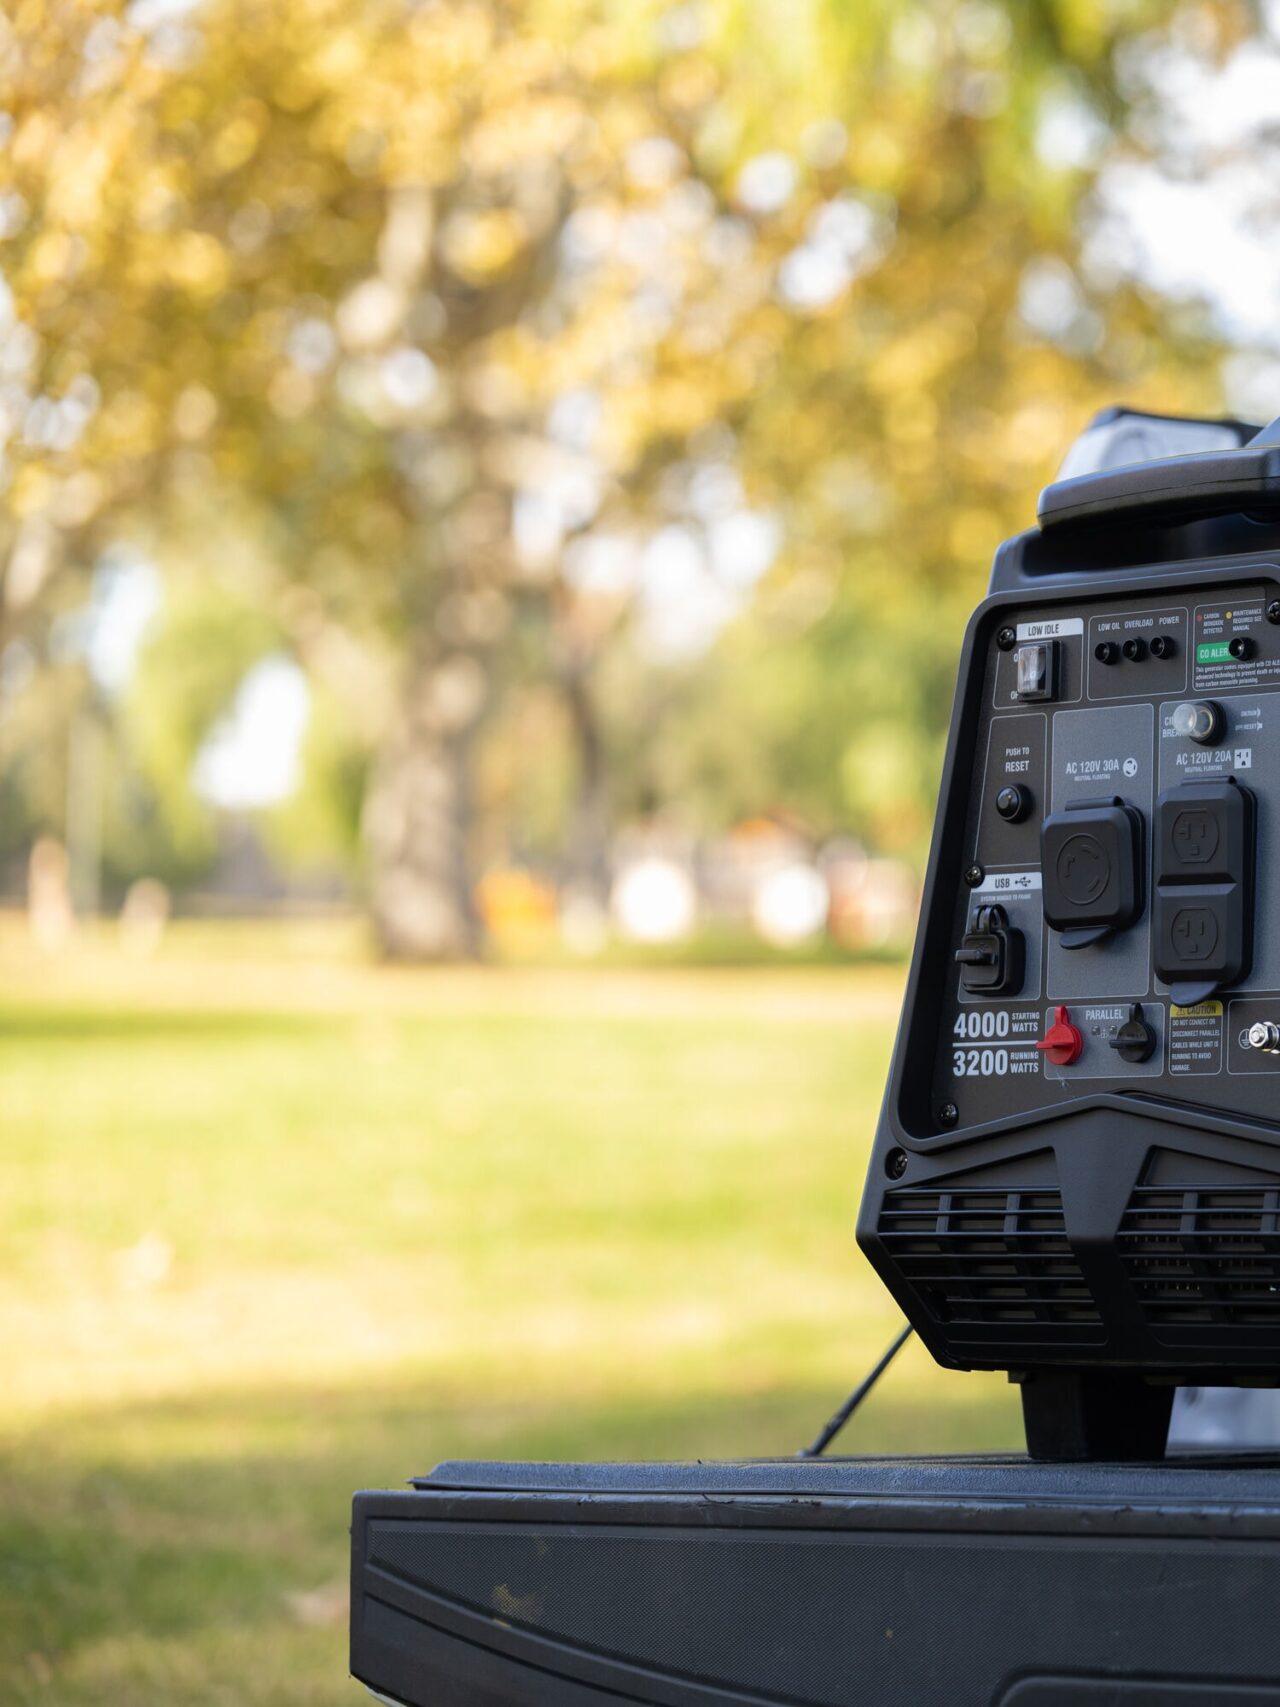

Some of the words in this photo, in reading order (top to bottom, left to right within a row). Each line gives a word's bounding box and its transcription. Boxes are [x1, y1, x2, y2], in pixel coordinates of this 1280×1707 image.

[1233, 608, 1262, 616] MAINTENANCE
[1124, 618, 1154, 629] OVERLOAD
[1159, 616, 1180, 624] POWER
[1028, 625, 1043, 636] LOW
[1044, 624, 1060, 634] IDLE
[1098, 623, 1110, 631] LOW
[1112, 622, 1120, 630] OIL
[1200, 649, 1209, 659] CO
[1210, 648, 1230, 658] ALER
[1006, 748, 1021, 756] PUSH
[1022, 747, 1030, 755] TO
[1176, 753, 1188, 765] AC
[1190, 752, 1212, 764] 120V
[1215, 750, 1232, 763] 20A
[1005, 760, 1030, 772] RESET
[1066, 762, 1077, 774] AC
[1080, 760, 1100, 773] 120V
[1103, 759, 1119, 771] 30A
[995, 878, 1010, 888] USB
[1012, 1012, 1040, 1020] STARTING
[1085, 1009, 1123, 1020] PARALLEL
[1187, 1006, 1216, 1015] CAUTION
[954, 1011, 1009, 1038] 4000
[1012, 1022, 1038, 1032] WATTS
[1010, 1051, 1039, 1060] RUNNING
[953, 1050, 1007, 1077] 3200
[1010, 1063, 1039, 1074] WATTS
